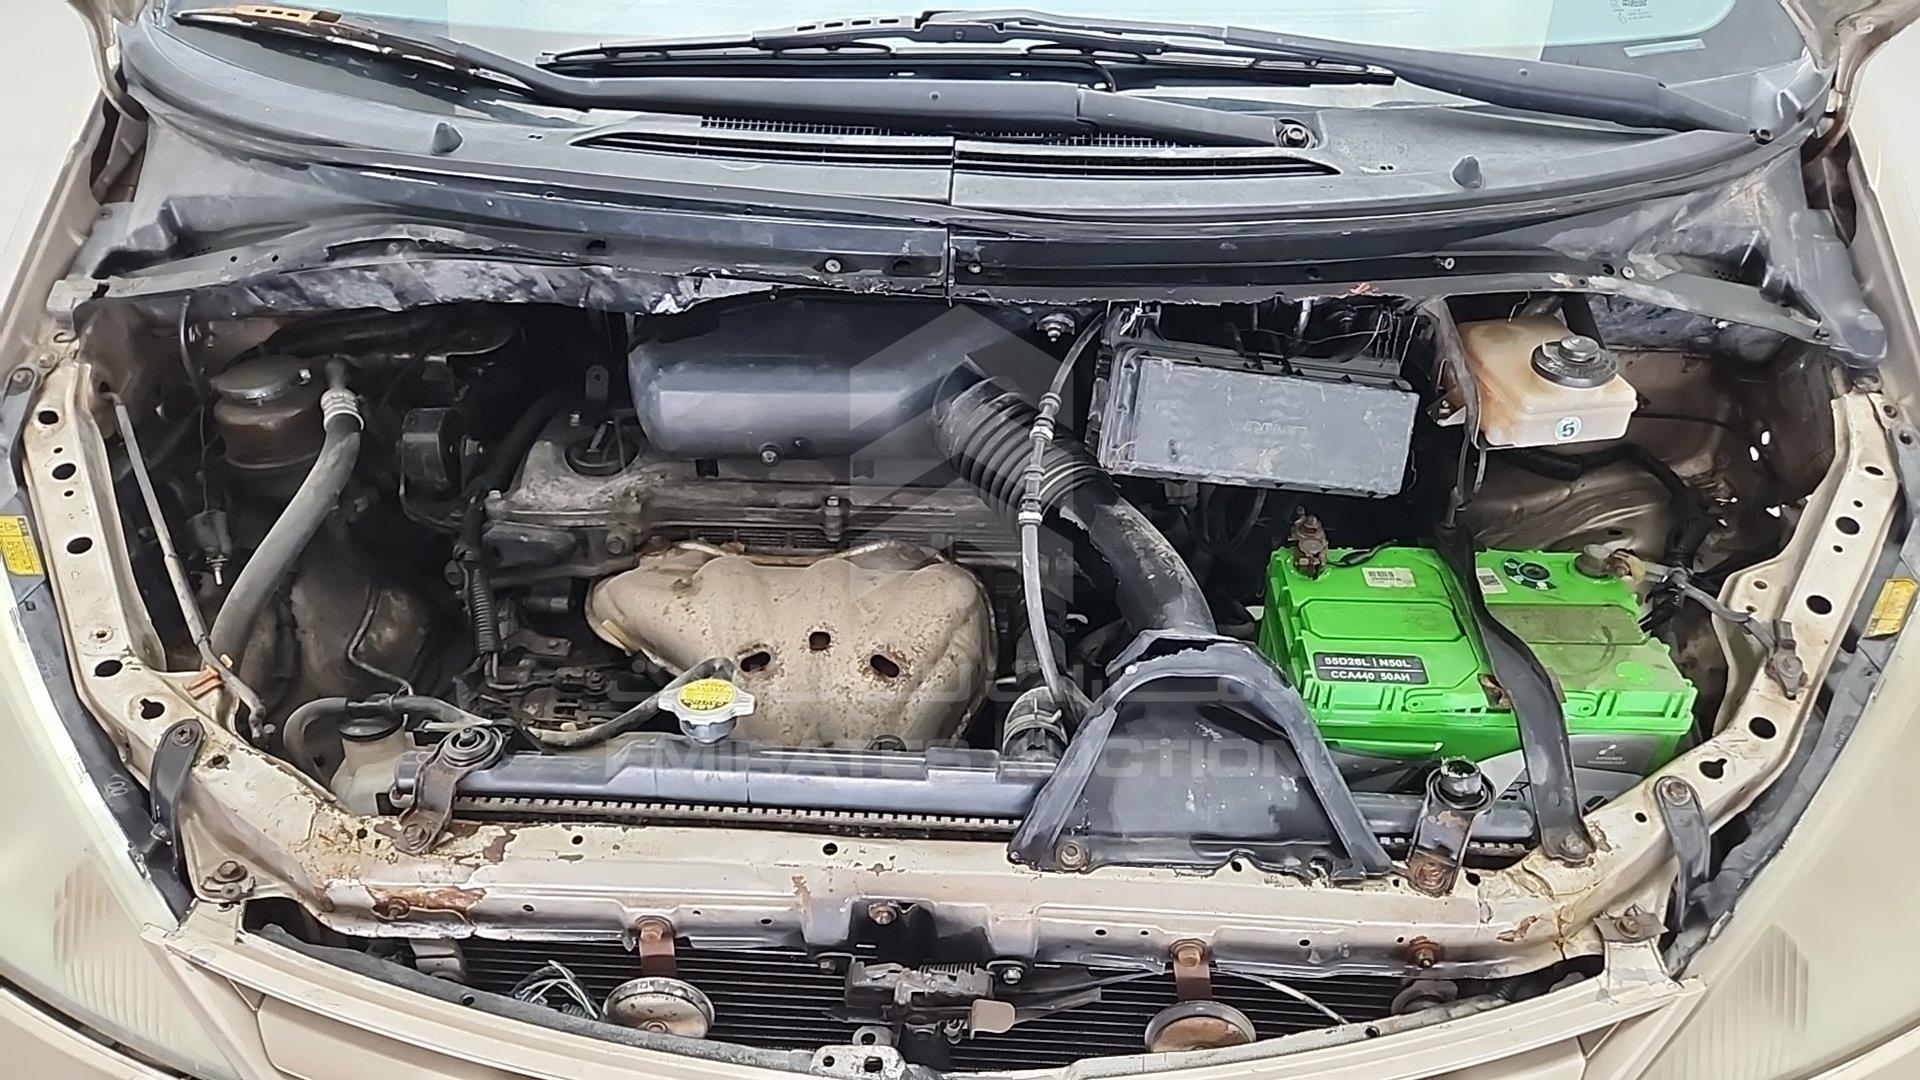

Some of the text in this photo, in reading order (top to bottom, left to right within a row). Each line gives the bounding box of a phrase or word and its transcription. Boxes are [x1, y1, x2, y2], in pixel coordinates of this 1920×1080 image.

[1379, 659, 1412, 668] N50L
[1330, 670, 1411, 682] CCA440 50AH
